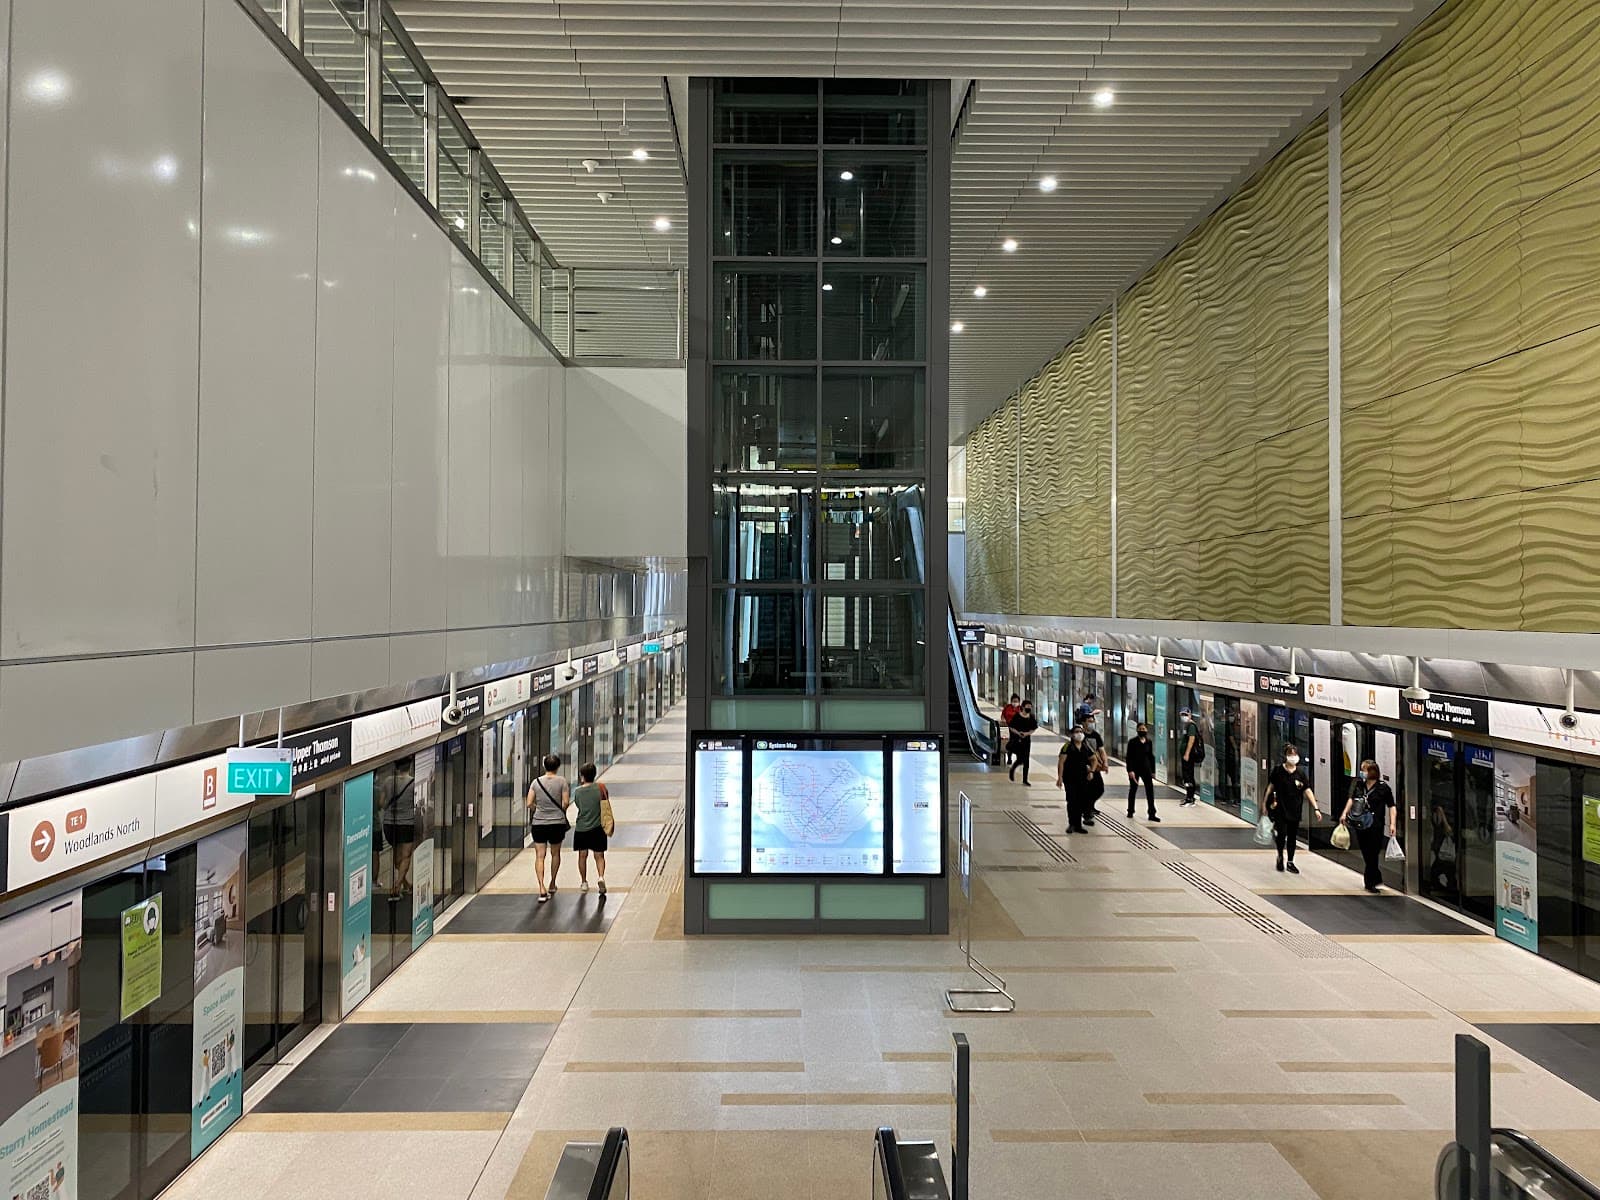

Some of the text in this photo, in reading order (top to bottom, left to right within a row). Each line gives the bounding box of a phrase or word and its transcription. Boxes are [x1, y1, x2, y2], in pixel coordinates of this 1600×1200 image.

[1425, 699, 1443, 713] Upper
[1443, 702, 1472, 716] Thomson
[292, 743, 312, 764] Upper
[312, 737, 339, 756] Thomson
[768, 741, 797, 750] System Map
[206, 775, 214, 796] B
[234, 768, 273, 788] EXIT
[64, 816, 140, 855] Woodlands North
[0, 1135, 26, 1160] Starry
[28, 1098, 74, 1140] Homestead
